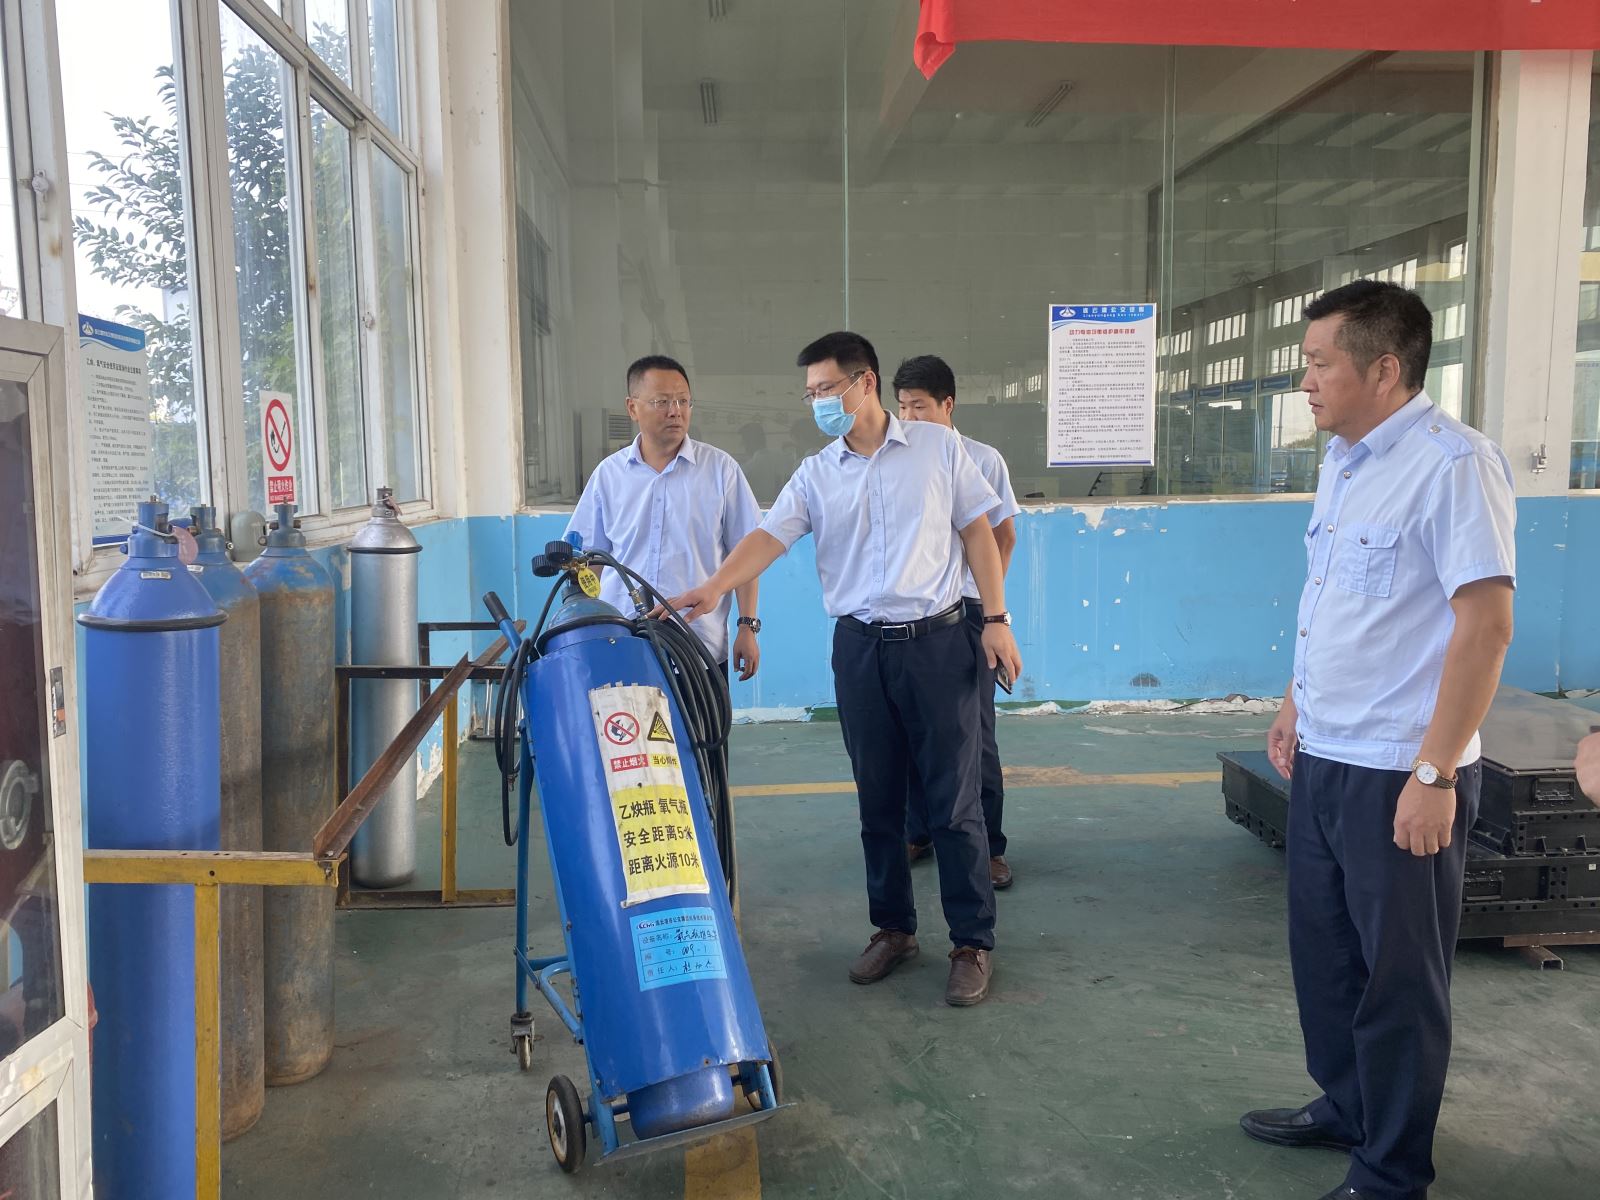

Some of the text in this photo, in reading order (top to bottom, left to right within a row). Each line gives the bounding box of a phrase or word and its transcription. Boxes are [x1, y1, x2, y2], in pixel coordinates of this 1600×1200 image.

[612, 756, 646, 769] 禁止烟火
[618, 797, 688, 820] 乙炔瓶 氧气瓶
[623, 824, 694, 848] 安全距离5米
[628, 852, 700, 876] 距离火源10米
